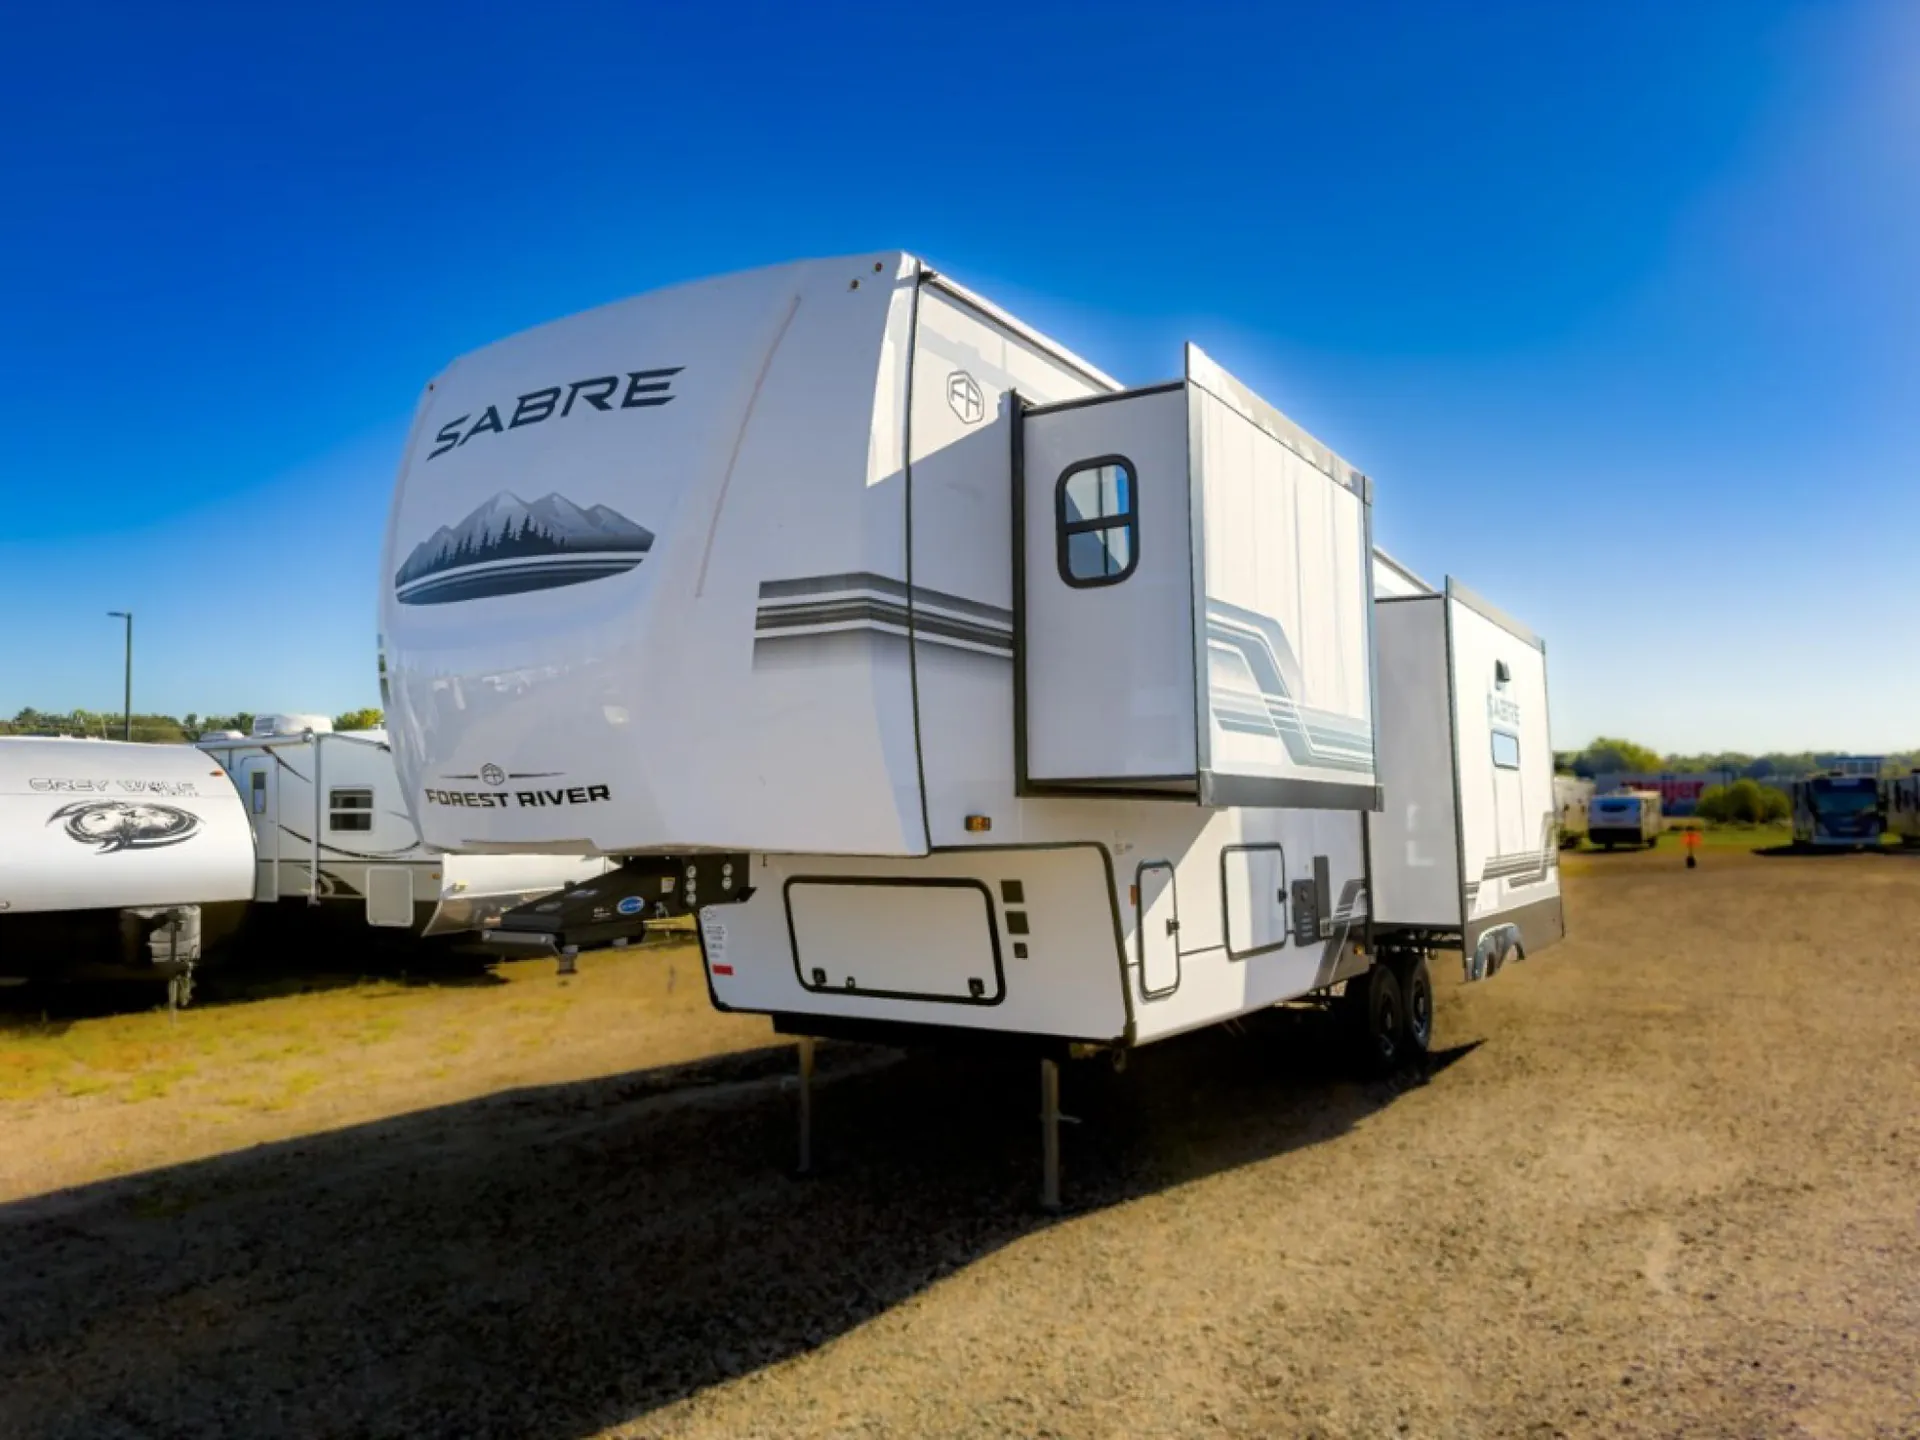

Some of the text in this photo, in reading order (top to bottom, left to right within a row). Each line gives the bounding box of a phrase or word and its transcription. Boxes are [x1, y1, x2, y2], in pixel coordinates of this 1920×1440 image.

[427, 366, 686, 461] SABRE
[425, 784, 611, 808] FOREST RIVER
